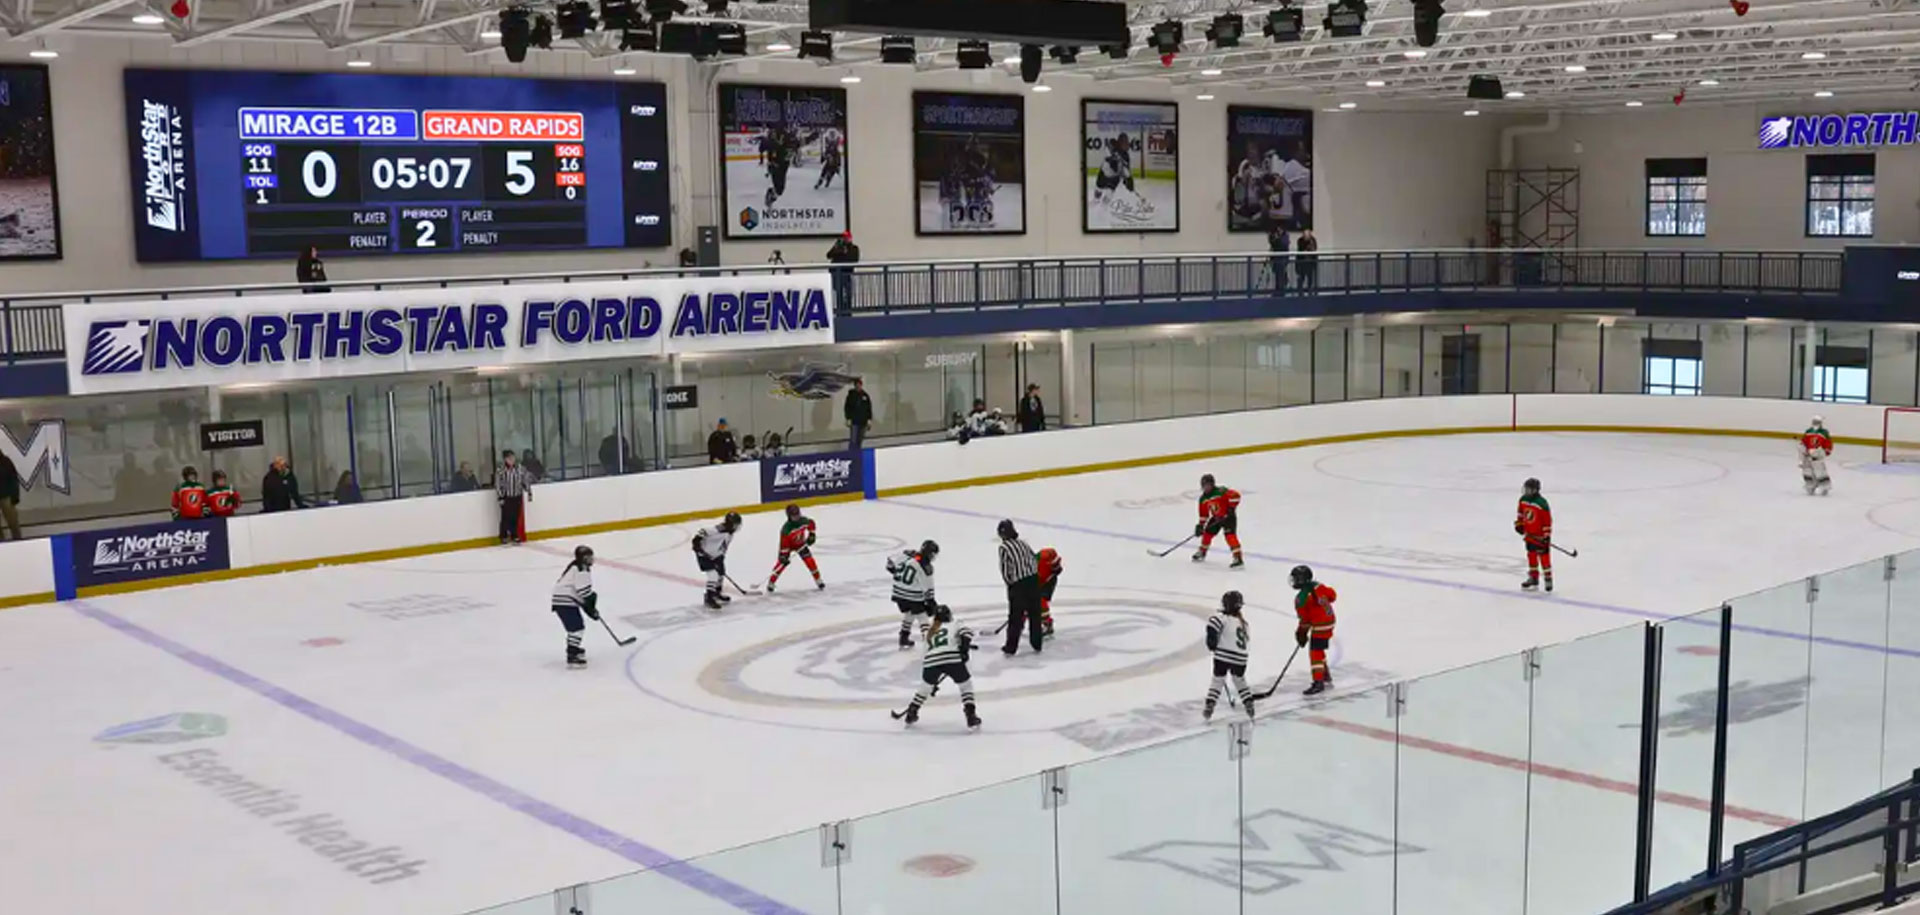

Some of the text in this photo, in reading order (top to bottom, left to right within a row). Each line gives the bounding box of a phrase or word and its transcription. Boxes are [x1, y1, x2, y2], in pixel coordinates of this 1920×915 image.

[243, 113, 397, 135] MIRAGE 12B
[427, 117, 579, 136] GRAND RAPIDS
[1790, 111, 1920, 148] NORTH
[142, 99, 166, 199] NorthStar
[171, 115, 186, 190] ARENA
[245, 145, 272, 156] SOG
[558, 146, 580, 156] SOG
[249, 157, 272, 172] 11
[560, 158, 579, 171] 16
[302, 150, 337, 198] 0
[372, 157, 471, 189] 05:07
[505, 151, 535, 195] 5
[562, 175, 581, 184] TOL
[249, 176, 273, 187] TOL
[256, 189, 268, 204] 1
[565, 187, 576, 199] 0
[353, 212, 387, 224] PLAYER
[403, 209, 448, 219] PERIOD
[462, 210, 494, 222] PLAYER
[762, 208, 835, 219] NORTHSTAR
[350, 235, 387, 247] PENALTY
[416, 220, 436, 247] 2
[463, 232, 498, 244] PENALTY
[152, 289, 830, 371] NORTHSTAR FORD ARENA
[208, 428, 256, 442] VISITOR
[794, 458, 852, 475] NorthStar
[799, 480, 844, 492] ARENA
[122, 529, 210, 552] NorthStar
[132, 555, 197, 572] ARENA
[272, 812, 427, 884] Health
